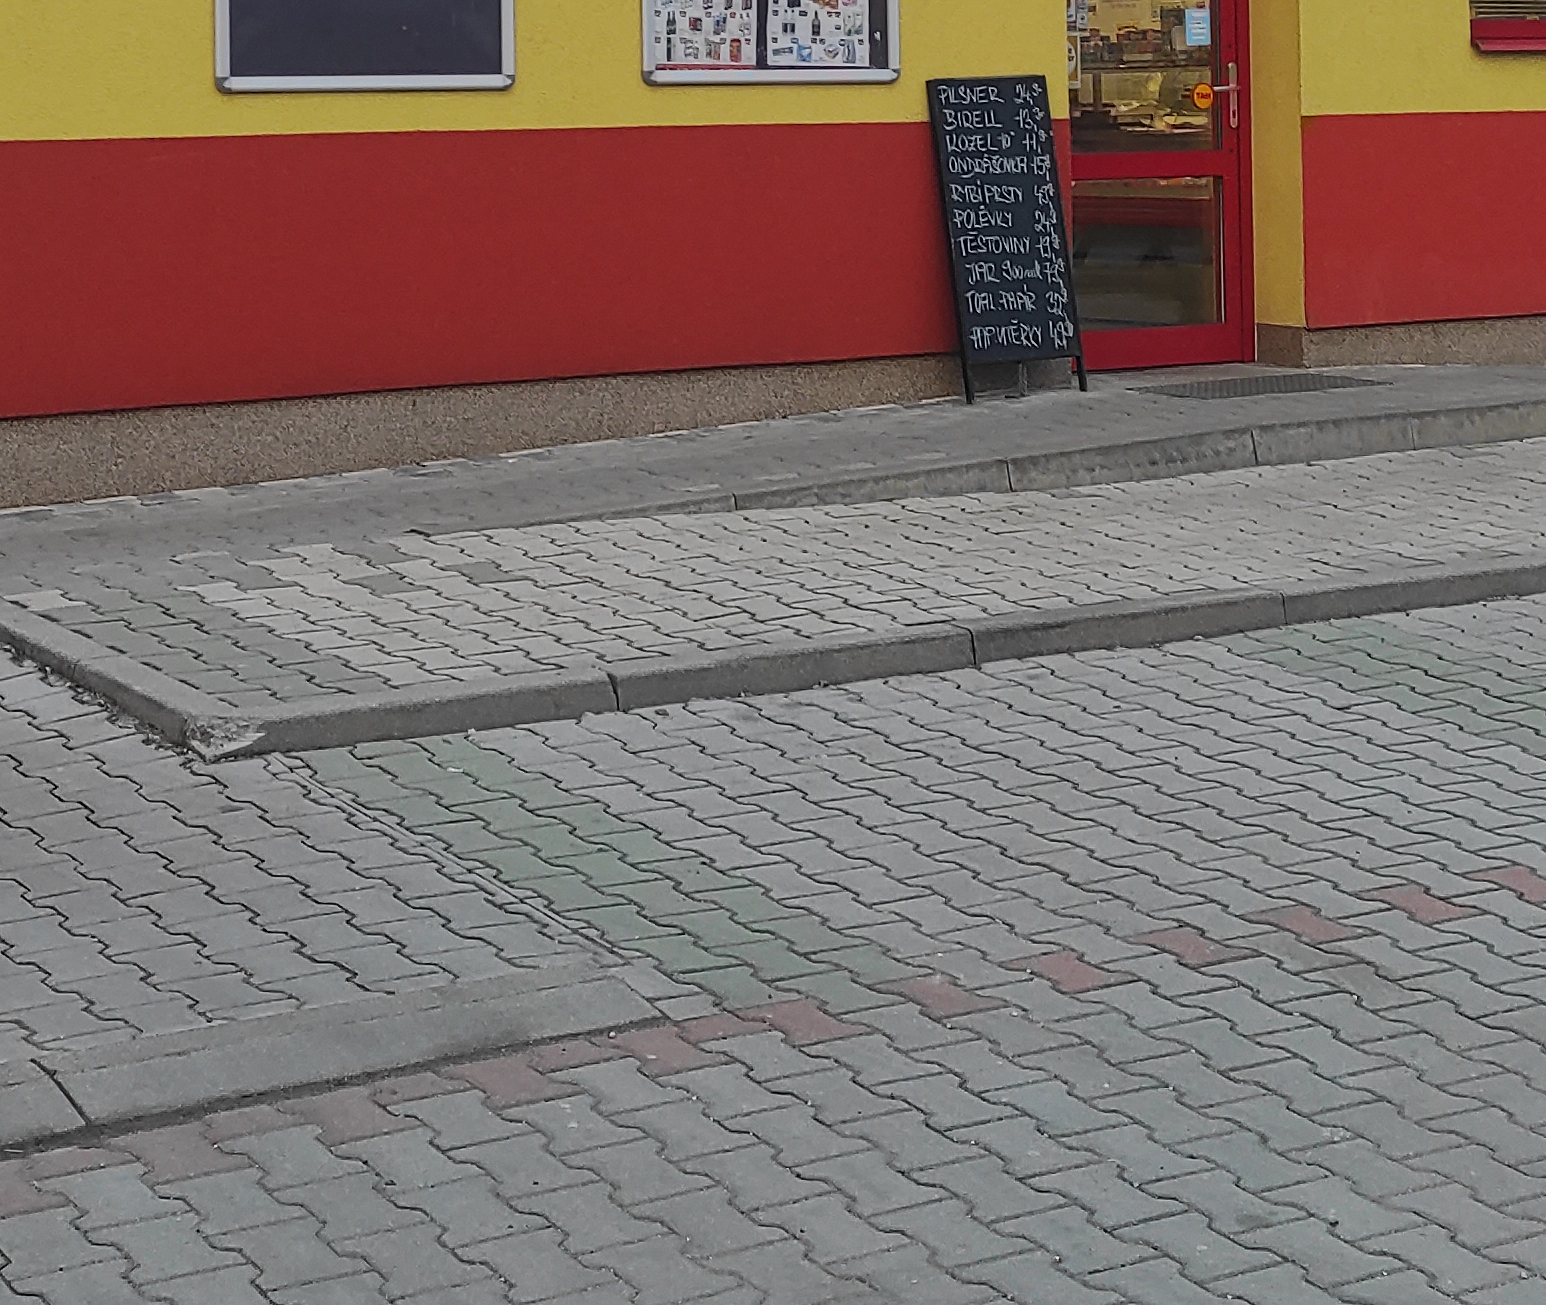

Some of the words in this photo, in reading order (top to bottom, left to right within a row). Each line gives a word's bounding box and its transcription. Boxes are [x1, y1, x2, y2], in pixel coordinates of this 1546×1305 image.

[937, 85, 1005, 105] PILSNER
[942, 109, 1003, 130] BIRELL
[946, 133, 999, 153] KOZEL
[965, 261, 1000, 285] JAR
